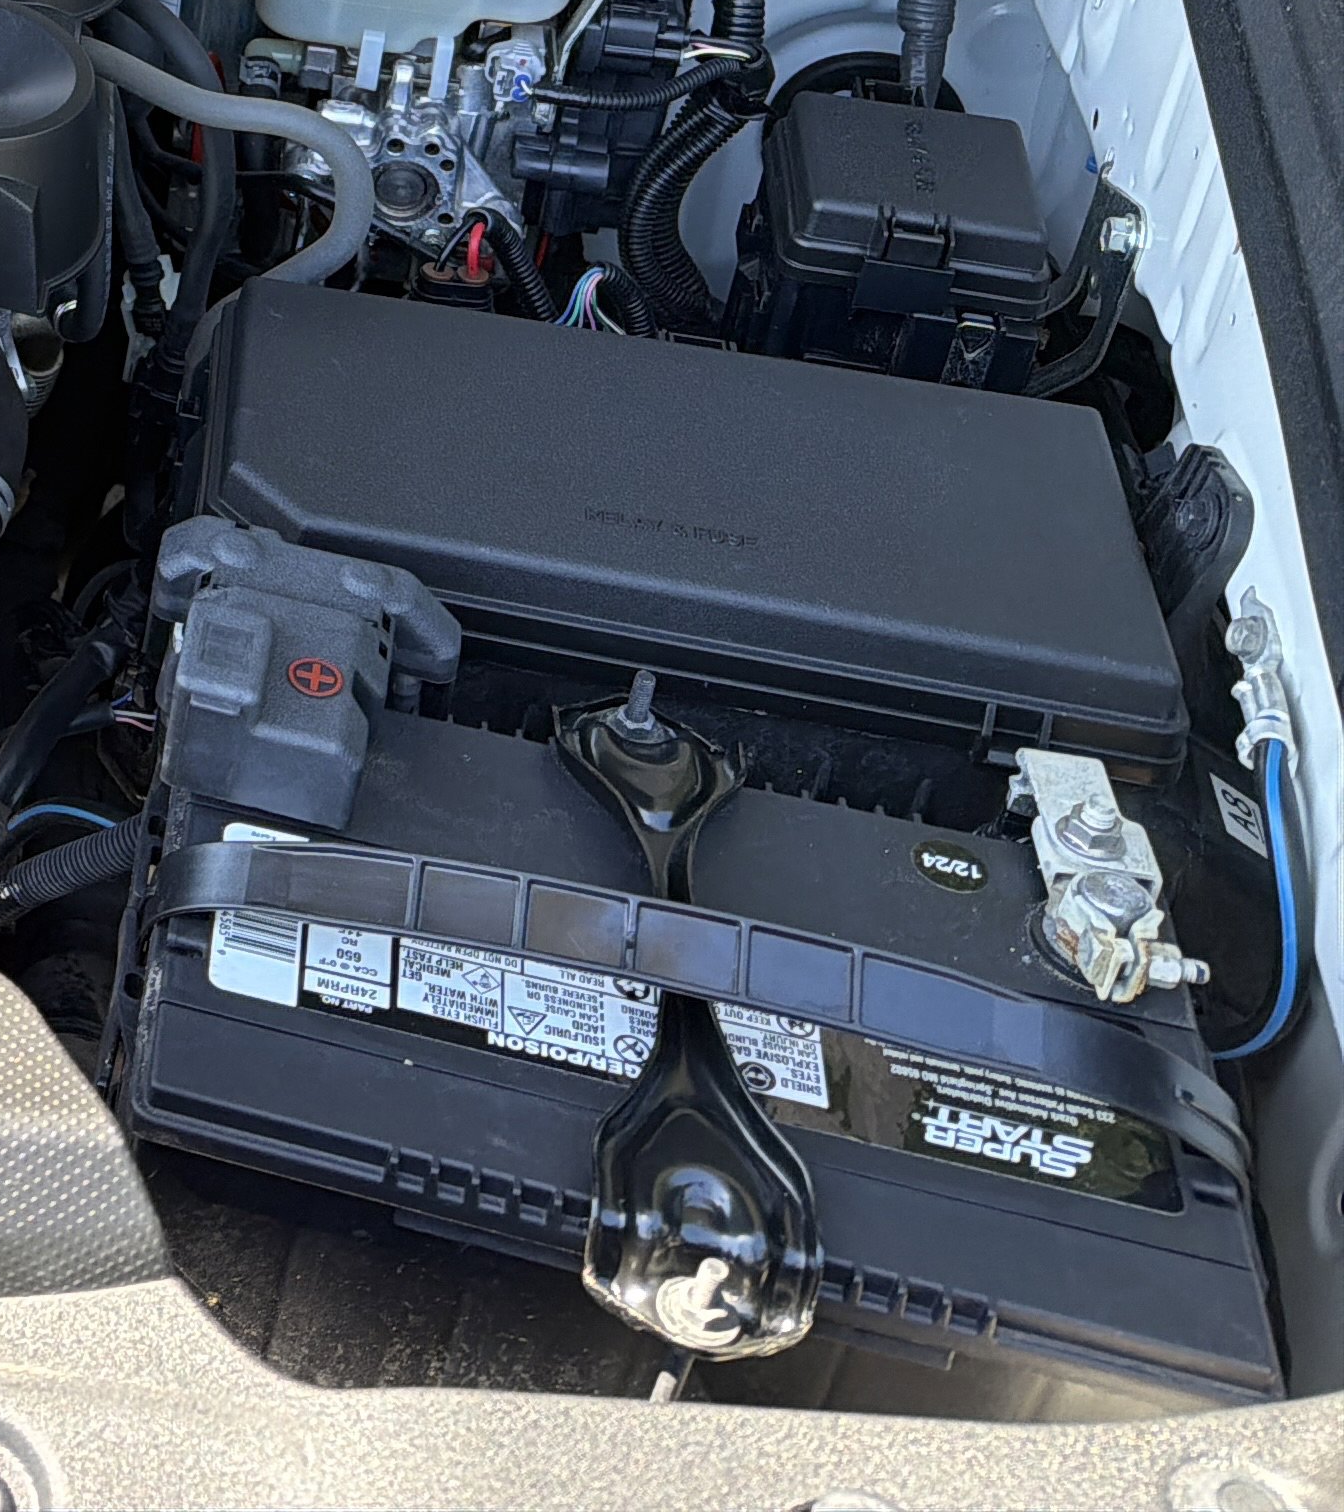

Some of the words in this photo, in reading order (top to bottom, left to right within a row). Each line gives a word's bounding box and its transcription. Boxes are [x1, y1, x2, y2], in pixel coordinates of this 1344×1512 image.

[1221, 789, 1256, 839] A8
[919, 850, 982, 880] 12/24
[340, 936, 358, 946] RC
[335, 947, 362, 962] 650
[480, 951, 502, 964] NOT
[503, 956, 518, 968] DO
[352, 964, 377, 977] CCA
[399, 957, 451, 978] MEDICAL
[433, 956, 464, 971] HELP
[400, 967, 423, 981] GET
[558, 969, 576, 981] ALL
[577, 973, 605, 988] READ
[316, 976, 377, 1000] 24RPRM
[525, 989, 541, 1000] OR
[559, 987, 598, 1003] SEVERE
[342, 999, 373, 1014] PART
[421, 992, 499, 1018] IMMEDIATELY
[468, 992, 499, 1008] WITH
[542, 992, 599, 1013] BLINDNESS
[430, 1004, 460, 1019] EYES
[542, 1002, 576, 1018] CAUSE
[577, 1011, 599, 1023] CAN
[723, 1007, 744, 1020] OUT
[462, 1011, 499, 1028] FLUSH
[570, 1018, 598, 1035] ACID
[627, 1015, 656, 1029] AMES
[745, 1012, 771, 1026] KEEP
[542, 1024, 599, 1046] SULFURIC
[628, 1024, 656, 1039] ARKS
[723, 1031, 759, 1047] BLIND
[727, 1042, 752, 1056] GAS
[761, 1040, 795, 1054] CAUSE
[801, 1040, 816, 1052] OR
[486, 1030, 643, 1079] GER/POISON
[753, 1048, 819, 1072] EXPLOSIVE
[795, 1047, 818, 1061] CAN
[778, 1076, 822, 1097] SHIELD
[920, 1102, 1094, 1164] START
[923, 1123, 1079, 1179] SUPER
